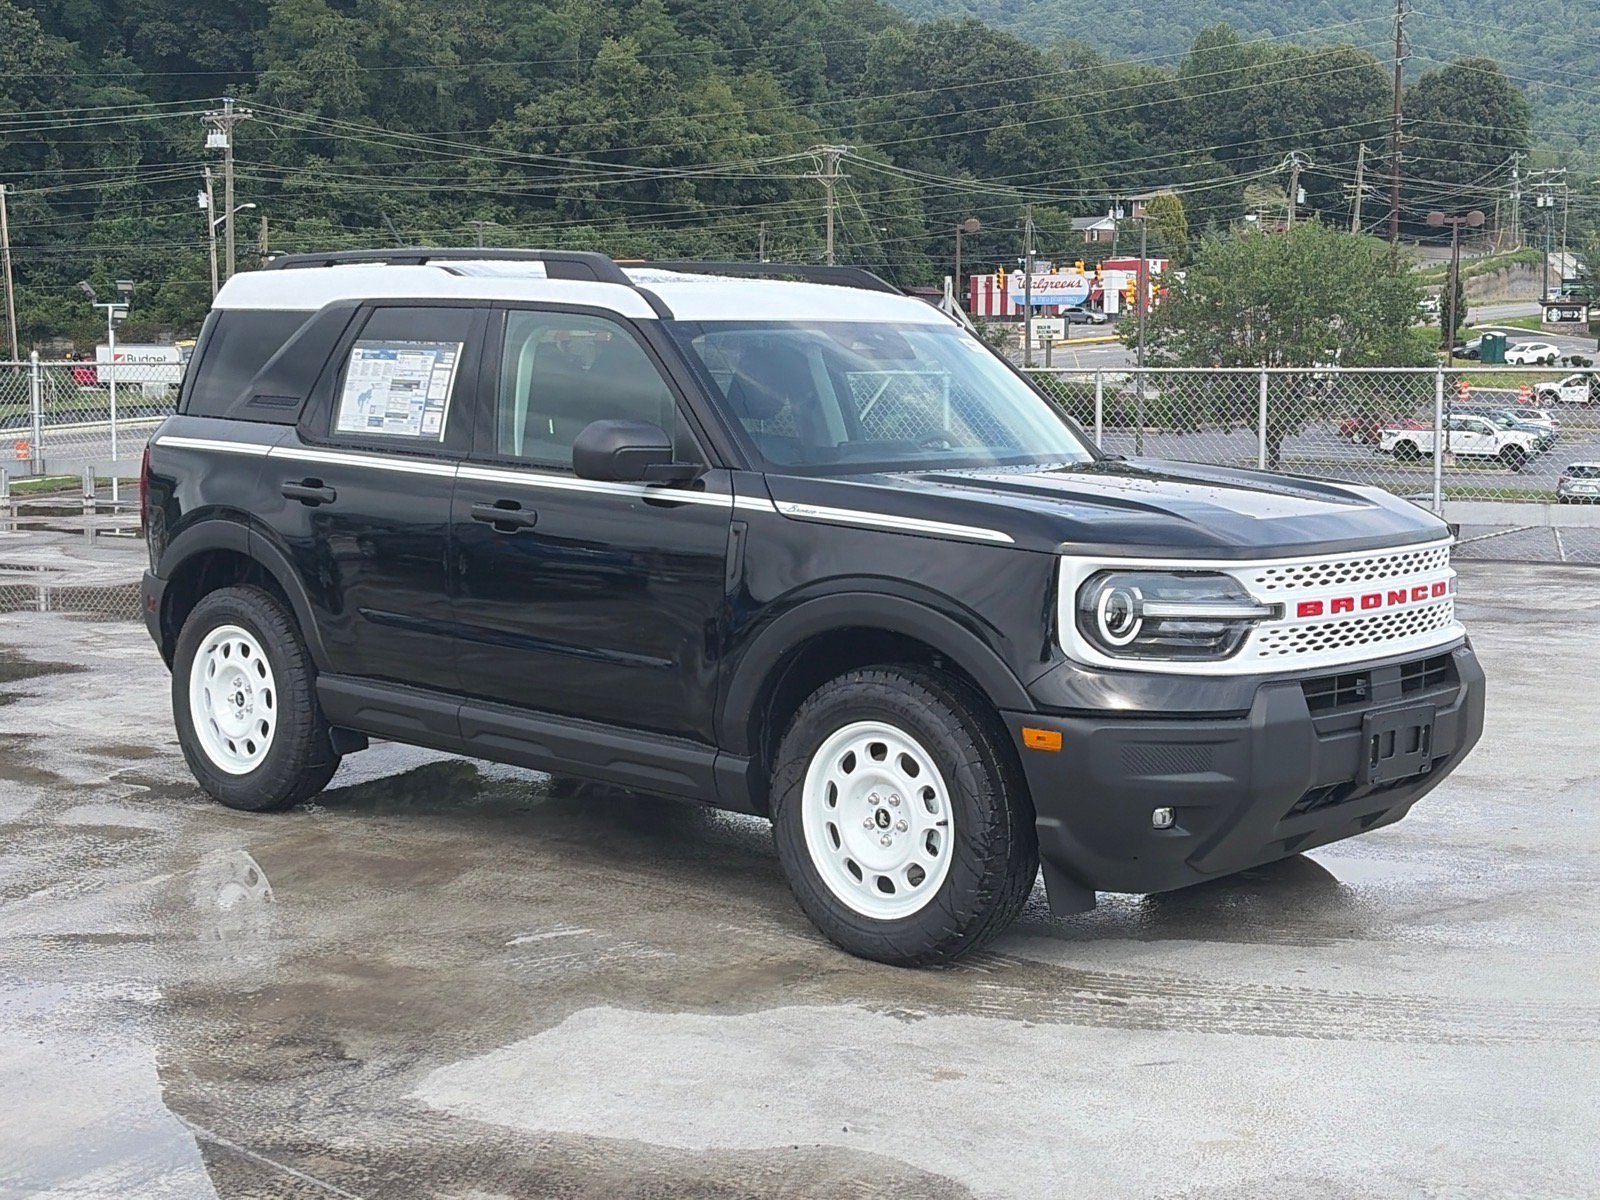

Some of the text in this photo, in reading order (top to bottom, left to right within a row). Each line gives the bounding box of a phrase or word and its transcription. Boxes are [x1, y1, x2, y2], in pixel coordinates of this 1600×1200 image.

[1015, 275, 1083, 293] Walgreens
[127, 354, 167, 367] Budget
[1297, 582, 1446, 617] BRONCO
